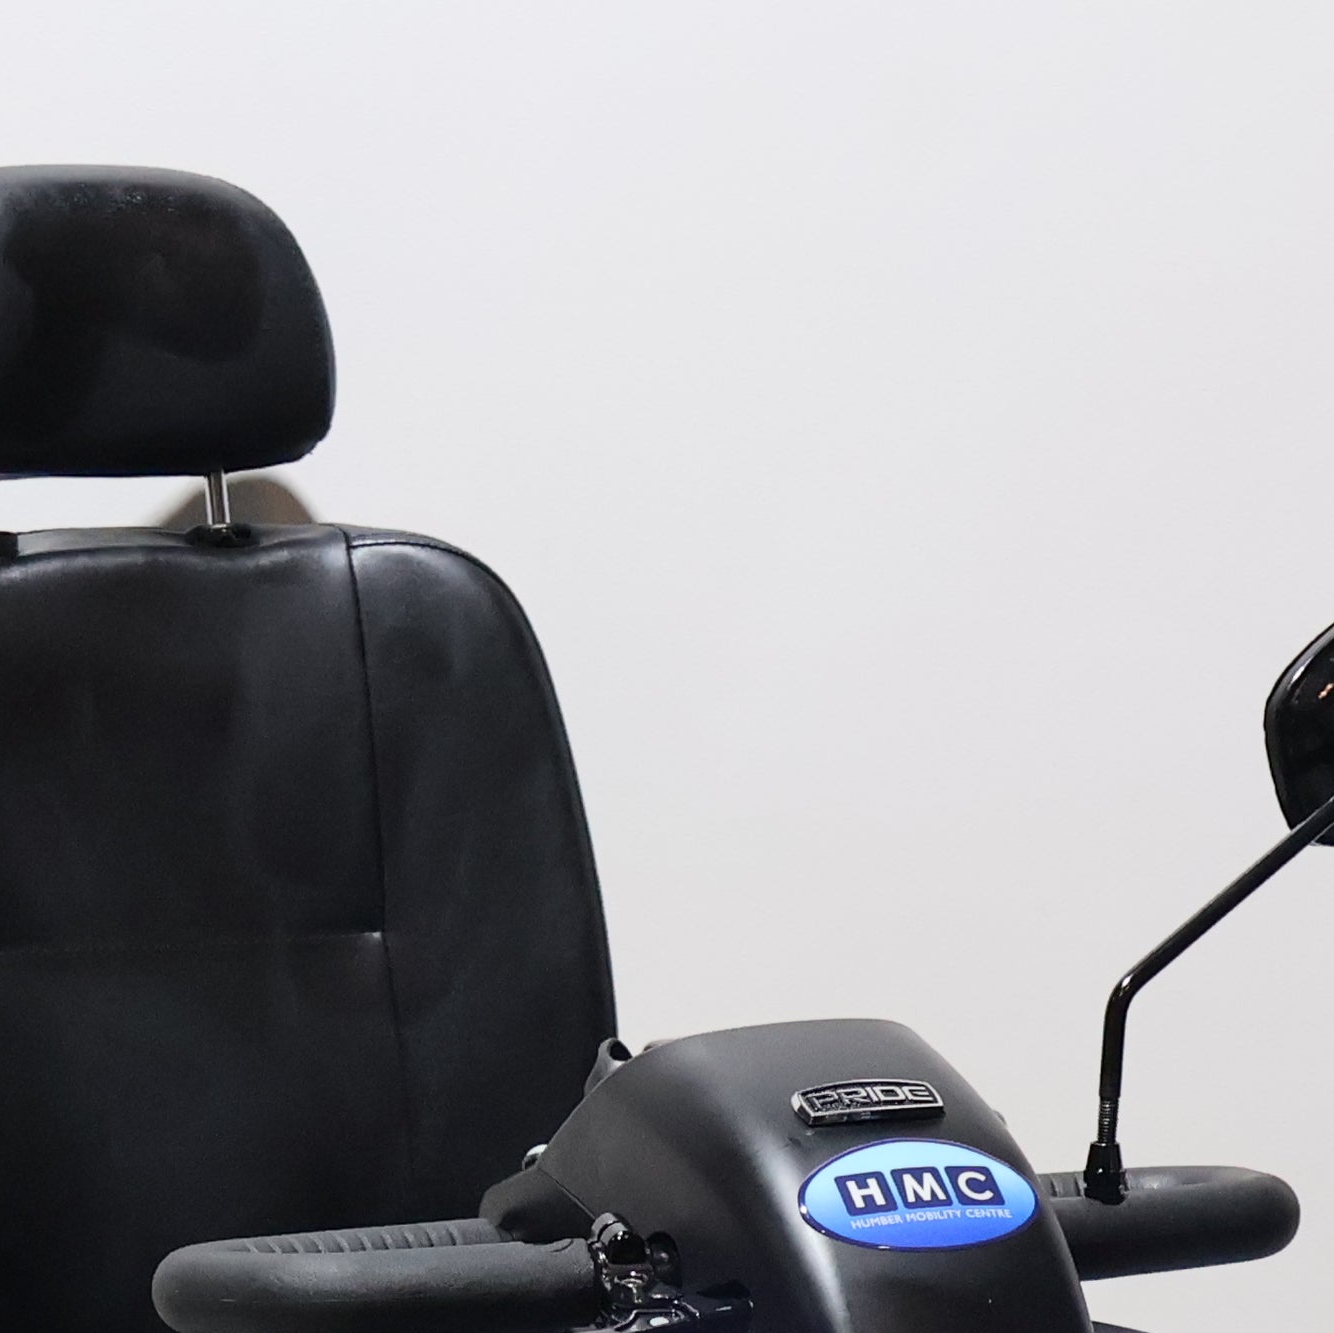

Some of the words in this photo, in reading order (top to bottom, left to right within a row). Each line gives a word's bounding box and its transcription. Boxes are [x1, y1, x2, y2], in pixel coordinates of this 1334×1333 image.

[805, 1085, 935, 1111] PRIDE
[845, 1170, 995, 1209] HMC
[850, 1214, 904, 1229] HUMBER
[906, 1209, 962, 1223] MOBILITY
[965, 1208, 1013, 1219] CENTRE
